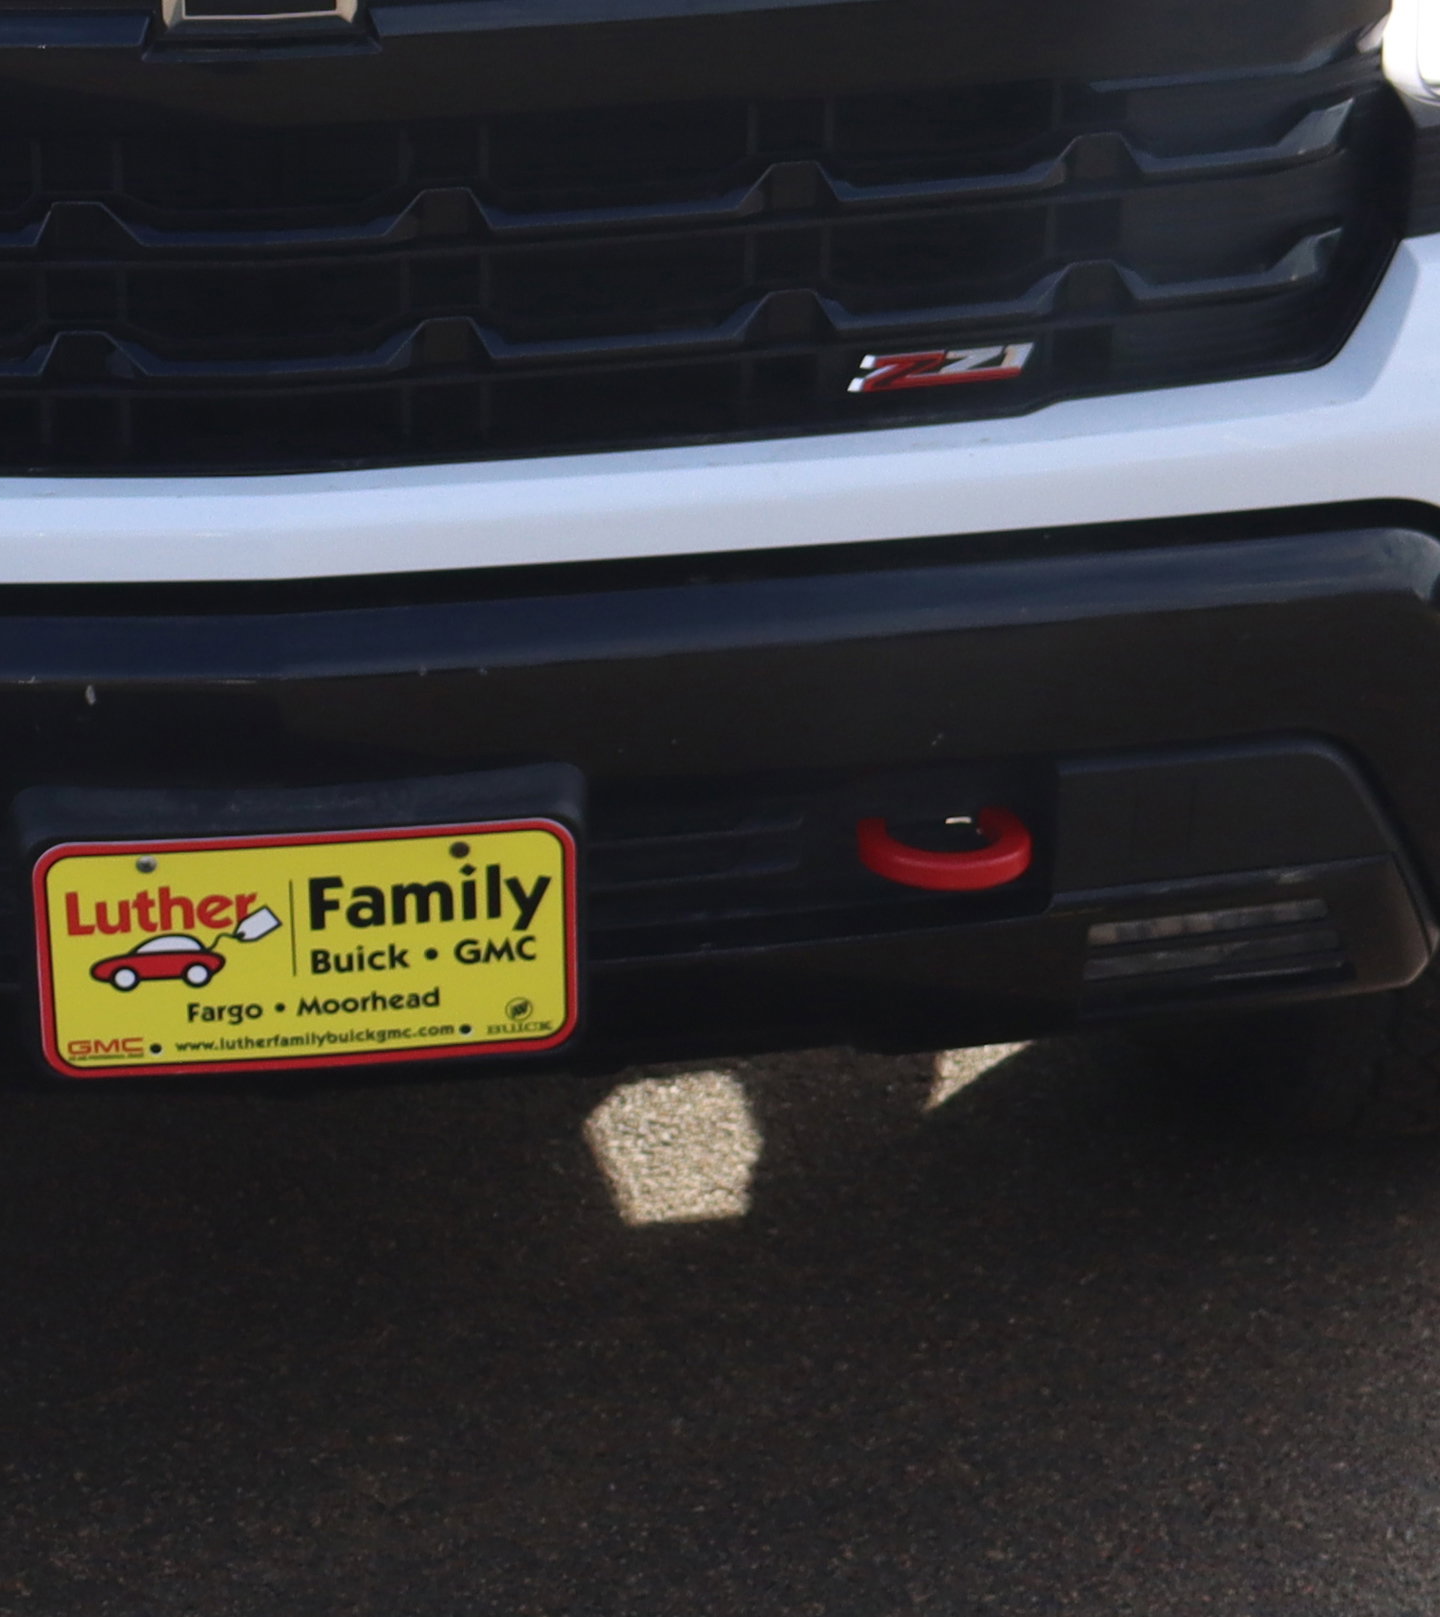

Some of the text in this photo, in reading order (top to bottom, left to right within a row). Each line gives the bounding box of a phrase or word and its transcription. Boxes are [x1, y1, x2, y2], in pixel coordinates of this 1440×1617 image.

[847, 342, 1035, 392] Z71
[64, 862, 552, 937] Luther Family
[309, 935, 538, 975] Buick GMC
[186, 986, 441, 1026] Fargo Moorhead
[67, 1037, 145, 1056] GMC
[174, 1023, 455, 1052] www.lutherfamilybuickgmc.com
[486, 1020, 554, 1035] BUICK
